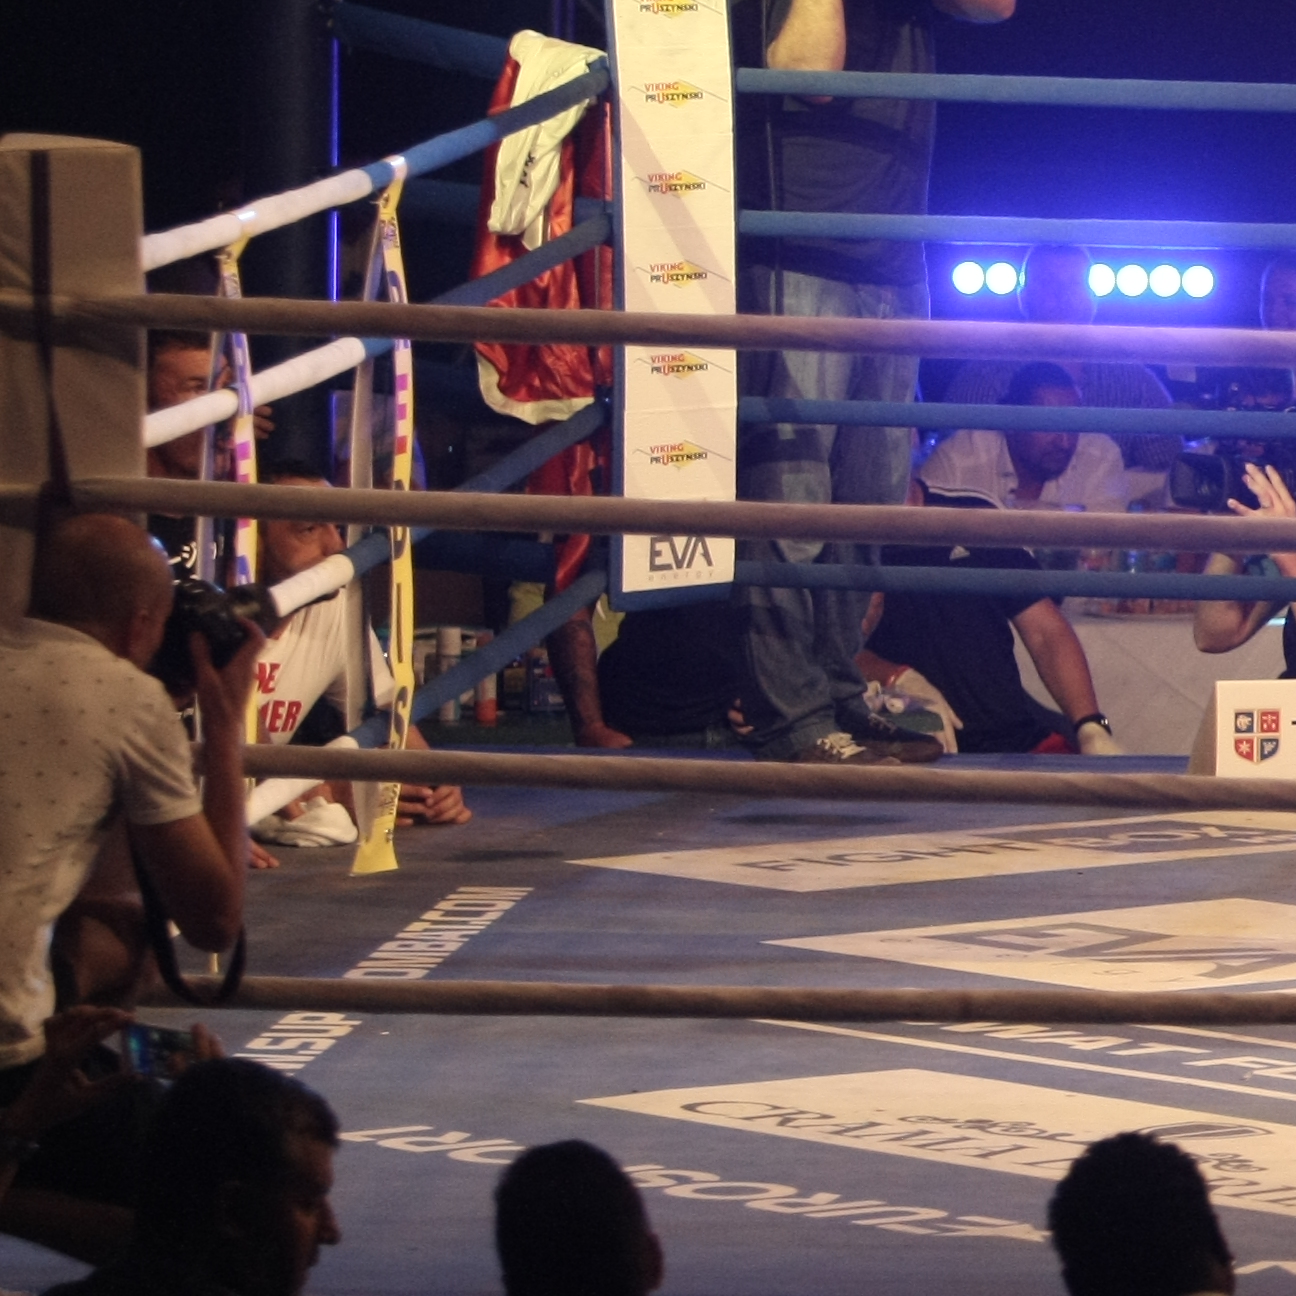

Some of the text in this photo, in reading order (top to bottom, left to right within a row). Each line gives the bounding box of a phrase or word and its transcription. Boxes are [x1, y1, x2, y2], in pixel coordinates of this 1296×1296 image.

[644, 82, 679, 92] VIKING
[648, 172, 682, 182] VIKING
[649, 262, 684, 272] VIKING
[651, 353, 685, 364] VIKING
[650, 443, 684, 454] VIKING
[649, 536, 714, 572] EVA
[733, 842, 1038, 872] FIGHT
[903, 1021, 1212, 1056] WAT
[680, 1101, 1038, 1159] CRAMA
